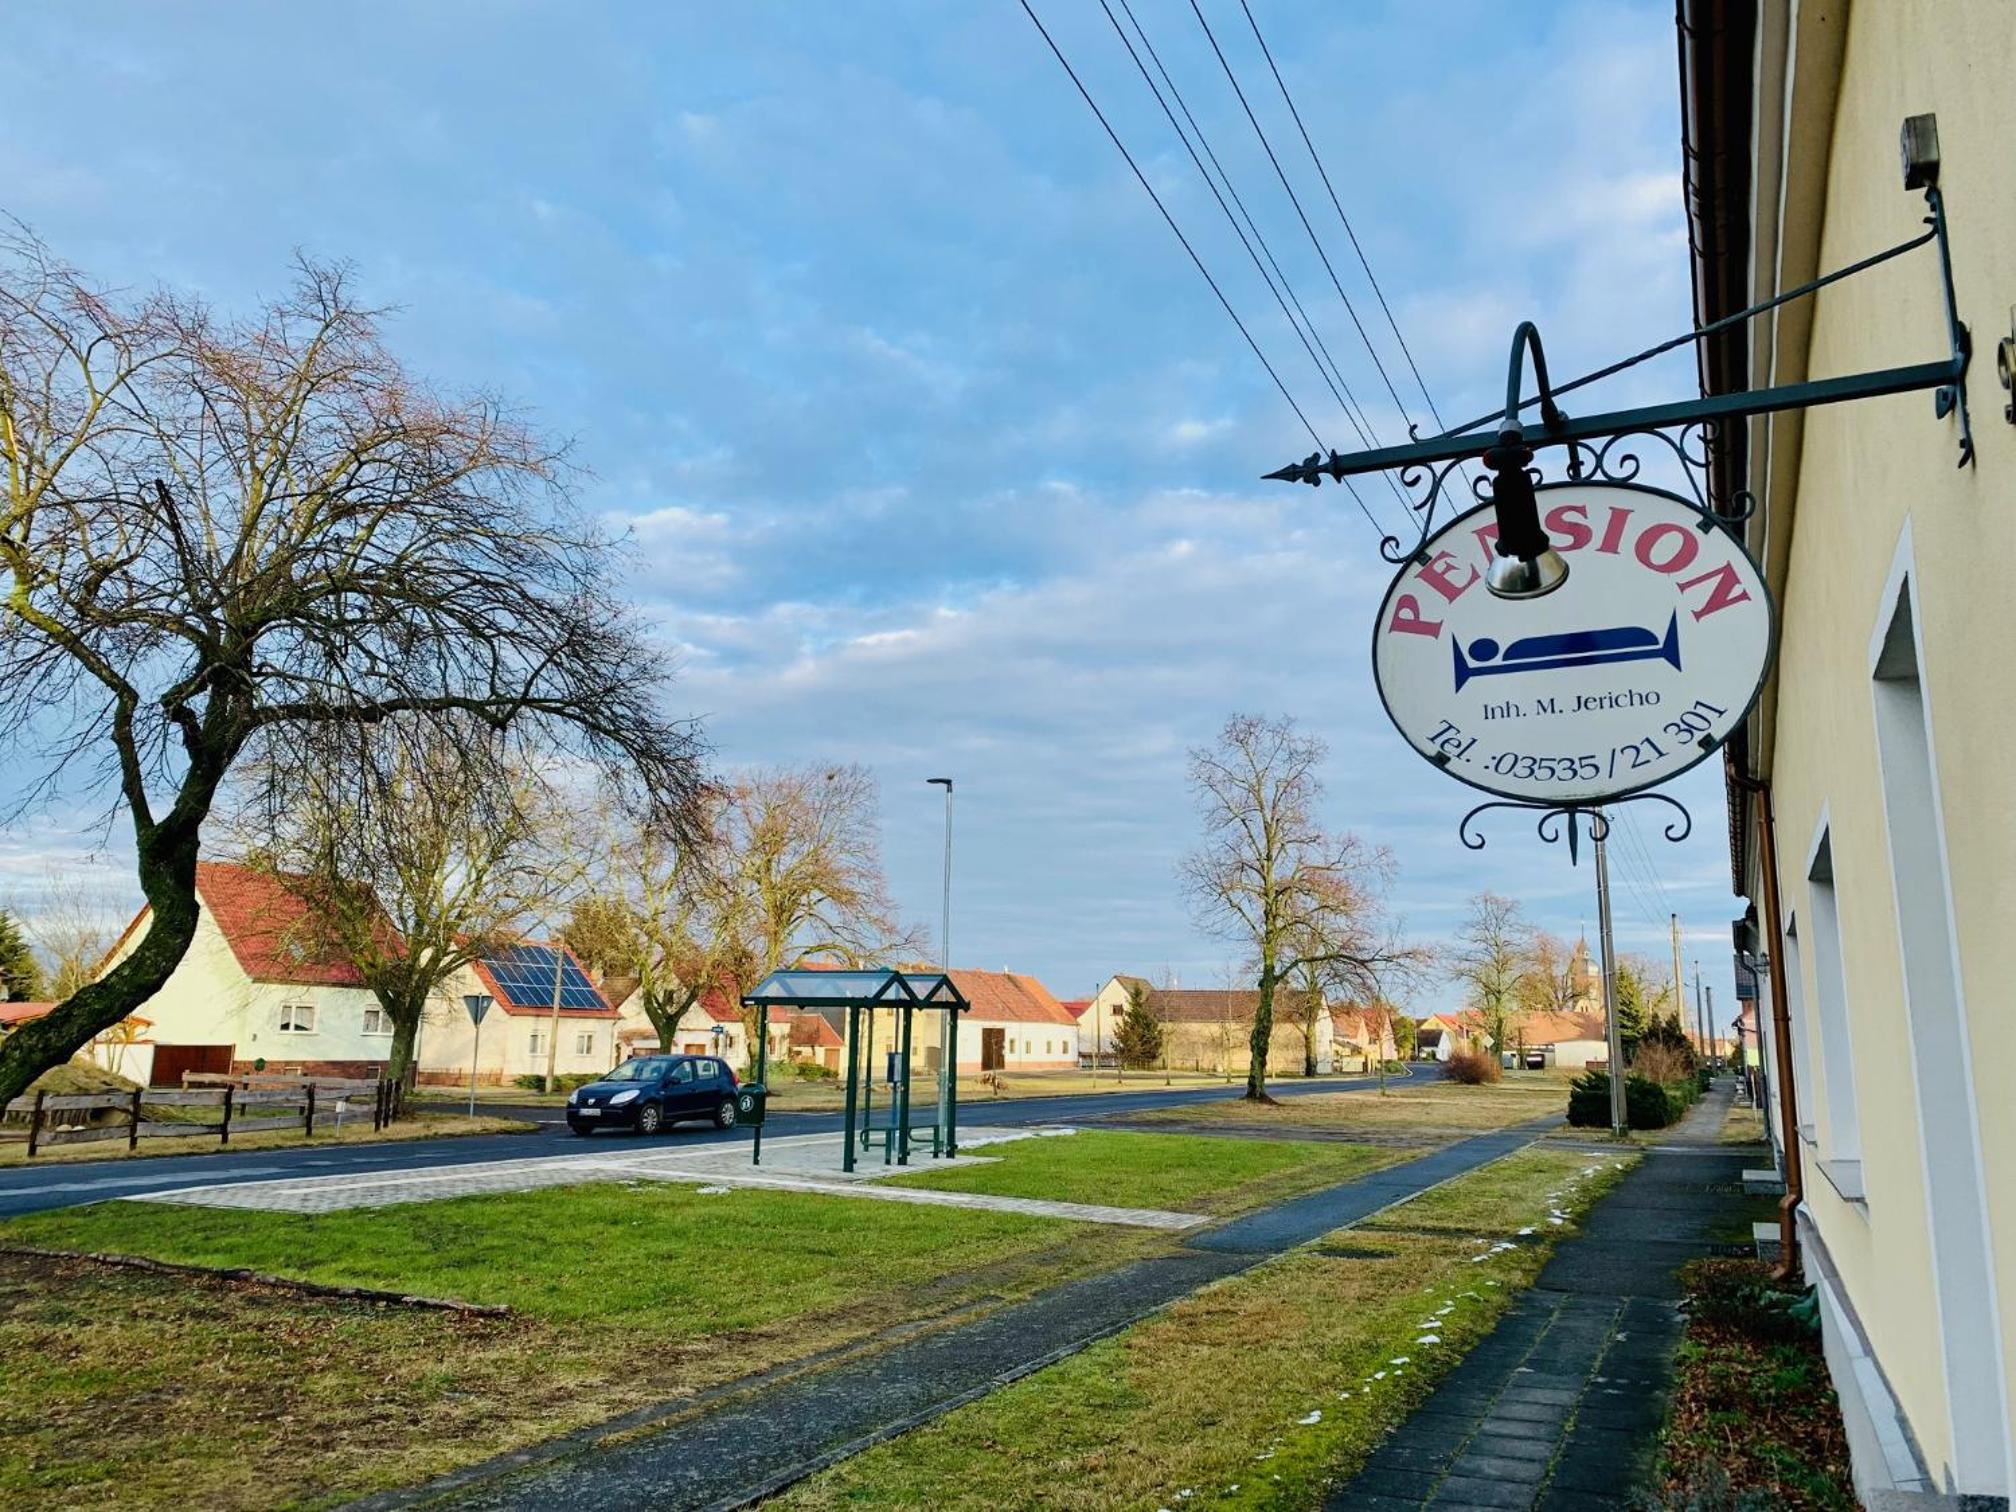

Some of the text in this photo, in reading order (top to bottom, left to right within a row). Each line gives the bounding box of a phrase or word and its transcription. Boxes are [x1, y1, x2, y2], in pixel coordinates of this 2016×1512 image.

[1483, 688, 1661, 721] Inh. M. Jericho
[1663, 700, 1729, 745] 301
